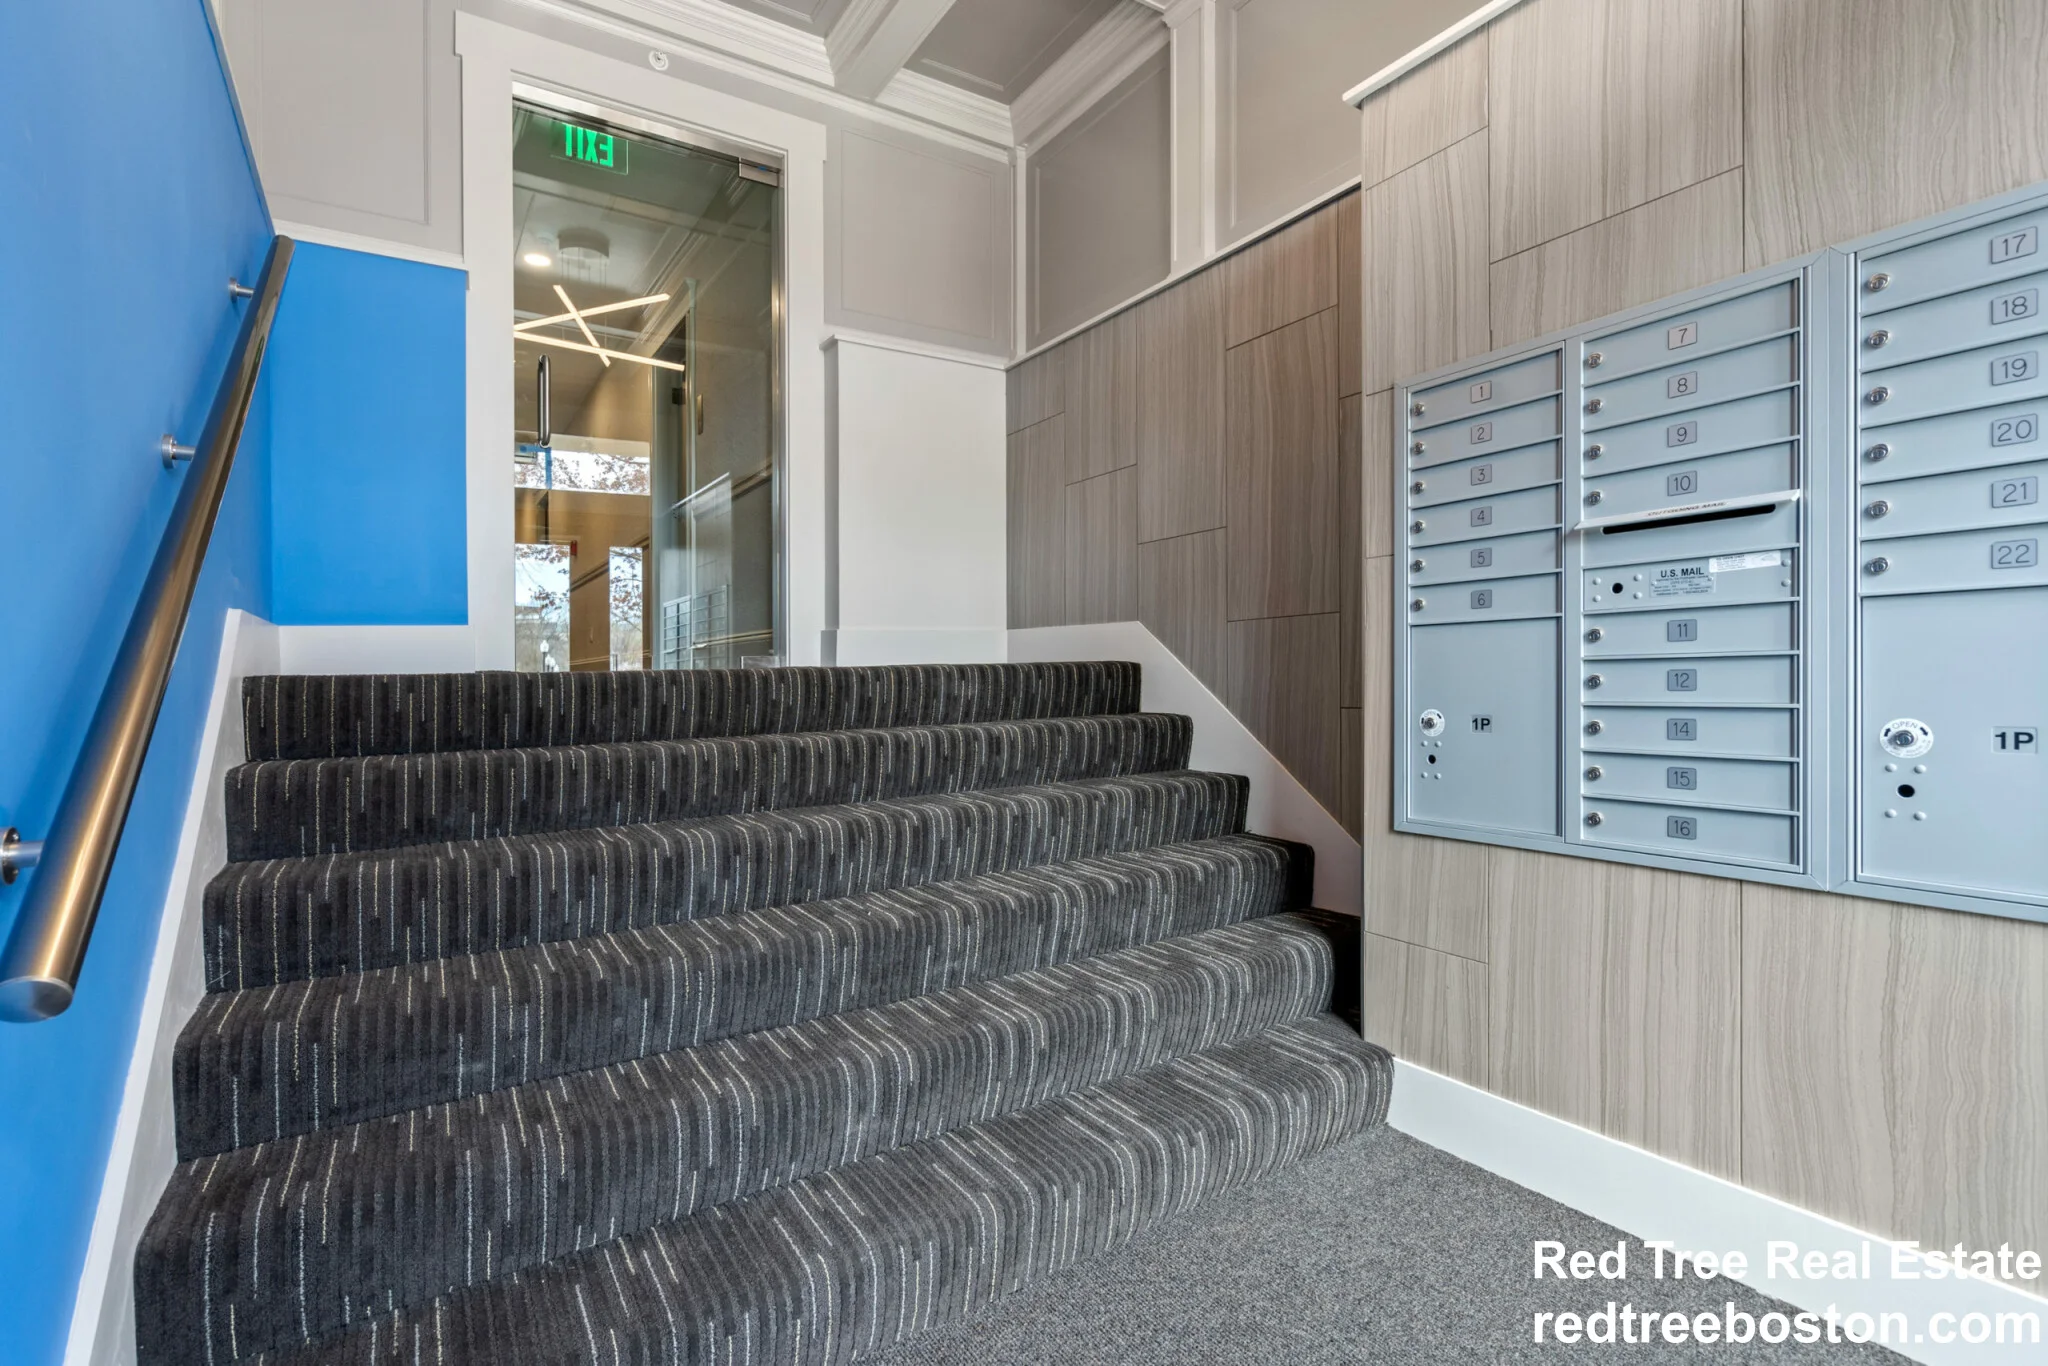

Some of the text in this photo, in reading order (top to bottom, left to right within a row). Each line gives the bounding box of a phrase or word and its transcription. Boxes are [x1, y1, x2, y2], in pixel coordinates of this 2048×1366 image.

[2002, 234, 2027, 256] 17
[2002, 296, 2028, 317] 18
[1678, 328, 1688, 344] 7
[2002, 358, 2028, 379] 19
[1677, 378, 1688, 393] 8
[1477, 427, 1485, 441] 2
[1676, 427, 1688, 443] 9
[1997, 420, 2032, 442] 20
[1477, 469, 1485, 482] 3
[1673, 475, 1691, 492] 10
[2002, 482, 2028, 503] 21
[1477, 510, 1485, 522] 4
[1477, 552, 1485, 565] 5
[1997, 544, 2031, 565] 22
[1660, 569, 1678, 578] U.S.
[1681, 567, 1704, 577] MAIL
[1477, 593, 1485, 606] 6
[1677, 623, 1688, 638] 11
[1674, 673, 1690, 688] 12
[1472, 718, 1491, 731] 1P
[1673, 722, 1690, 737] 14
[1892, 720, 1918, 730] OPEN
[1995, 732, 2034, 750] 1P
[1673, 771, 1690, 787] 15
[1674, 819, 1691, 836] 16
